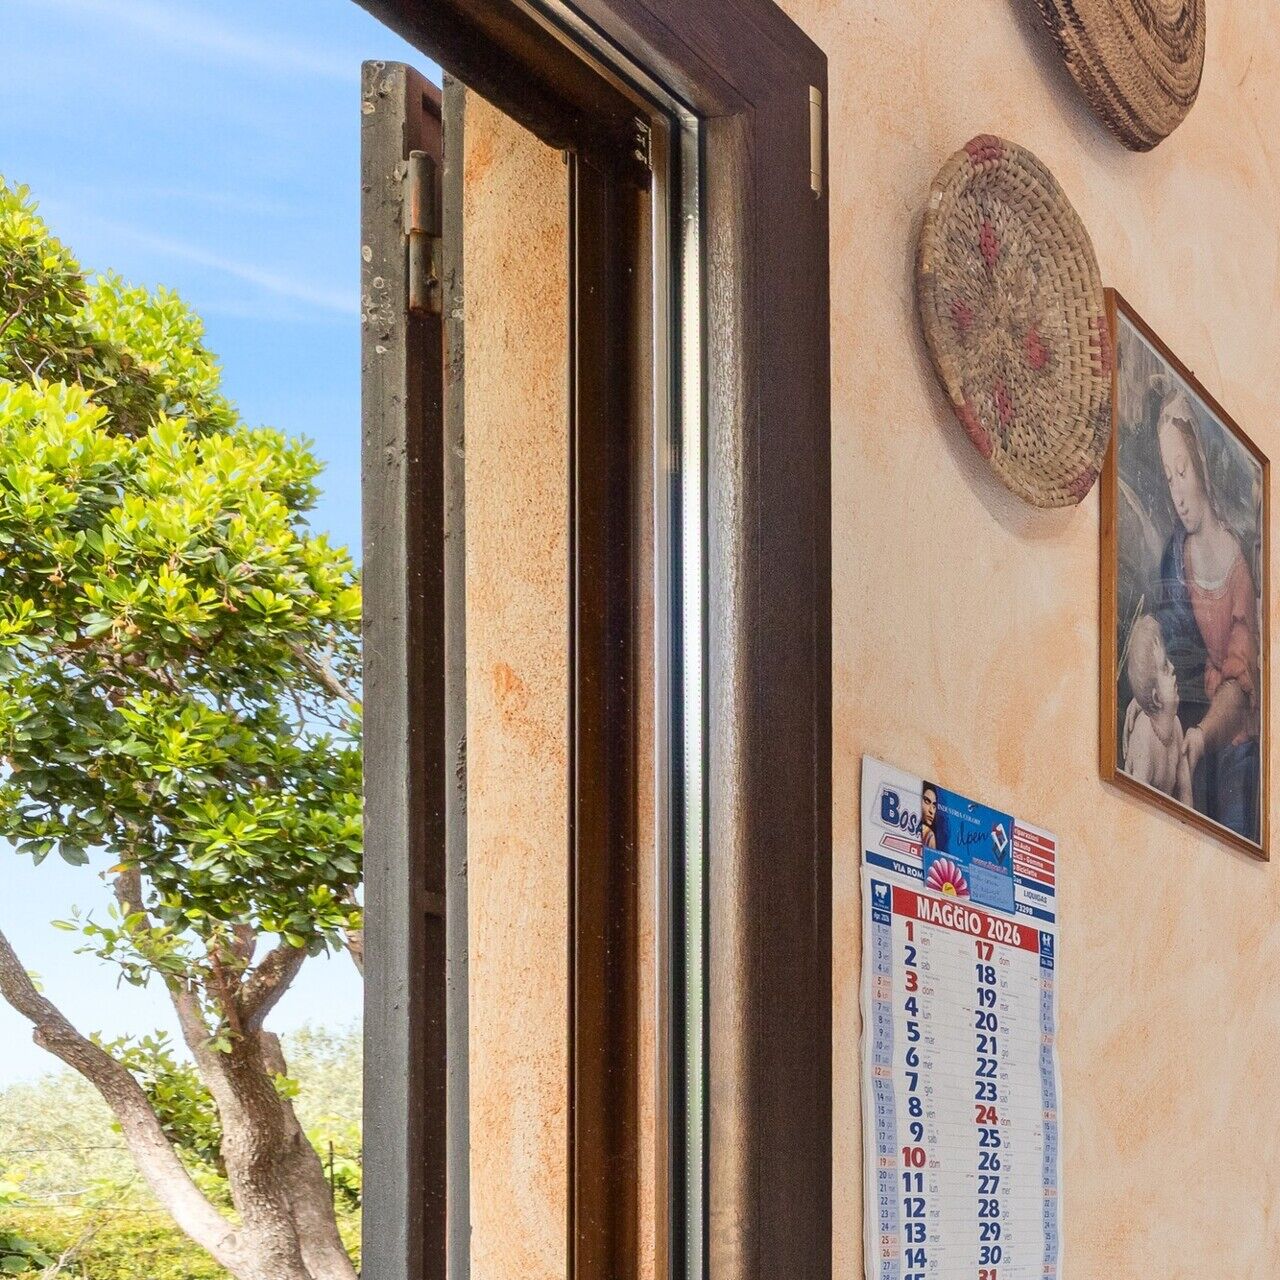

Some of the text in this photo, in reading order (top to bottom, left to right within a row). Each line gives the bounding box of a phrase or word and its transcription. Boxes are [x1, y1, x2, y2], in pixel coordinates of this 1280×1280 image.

[893, 862, 906, 874] VIA
[905, 921, 914, 941] 1
[916, 896, 1021, 946] MAGGIO 2026
[905, 945, 917, 967] 2
[975, 940, 994, 961] 17
[905, 971, 918, 992] 3
[976, 964, 996, 985] 18
[905, 996, 918, 1017] 4
[976, 987, 996, 1008] 19
[975, 1010, 998, 1032] 20
[907, 1021, 920, 1042] 5
[976, 1033, 997, 1055] 21
[906, 1047, 919, 1067] 6
[975, 1057, 998, 1079] 22
[905, 1072, 918, 1091] 7
[975, 1081, 998, 1101] 23
[908, 1096, 922, 1117] 8
[975, 1104, 998, 1125] 24
[910, 1122, 924, 1142] 9
[978, 1128, 1001, 1148] 25
[902, 1147, 940, 1168] 10 dom
[978, 1152, 1000, 1171] 26
[903, 1172, 923, 1192] 11
[978, 1175, 999, 1195] 27
[904, 1198, 926, 1218] 12
[978, 1199, 1000, 1218] 28
[904, 1222, 926, 1243] 13
[979, 1222, 1000, 1242] 29
[905, 1248, 927, 1268] 14
[978, 1246, 1002, 1265] 30
